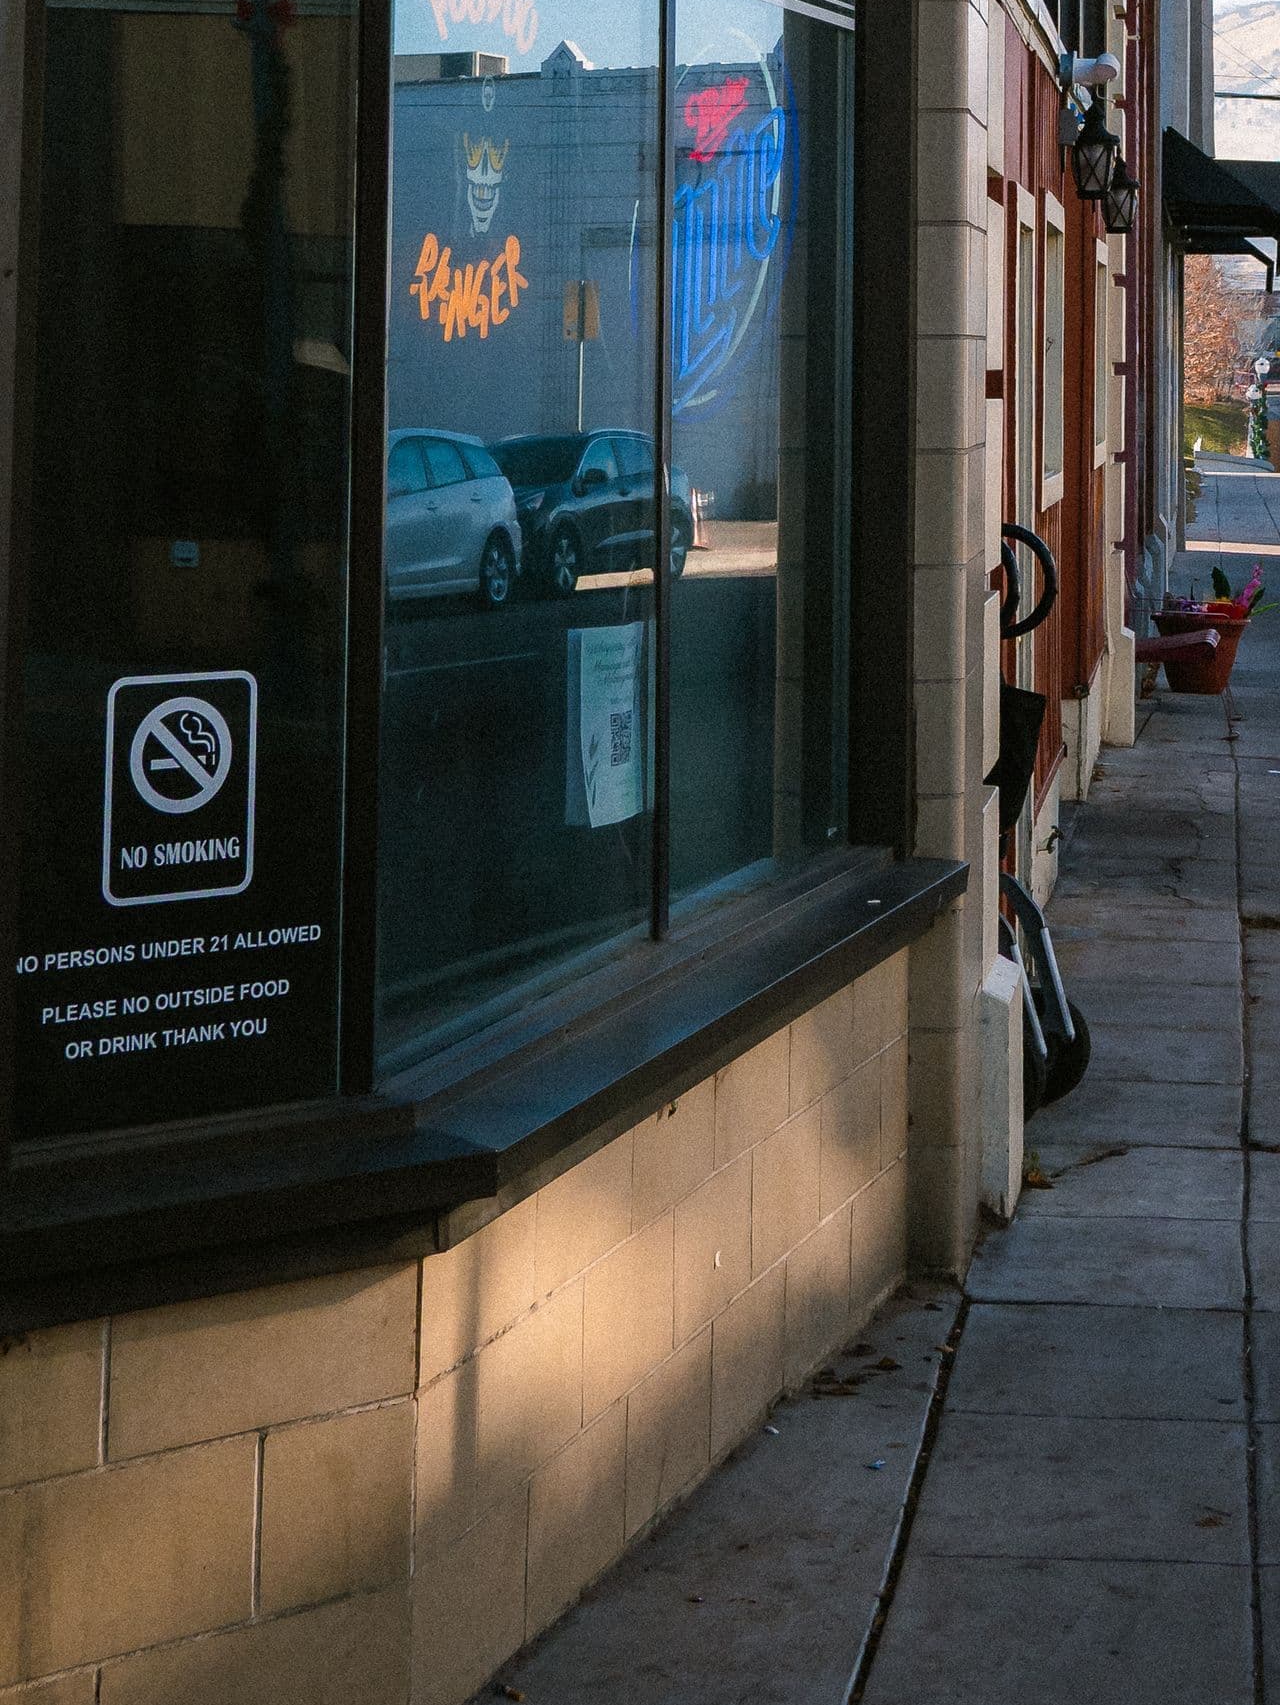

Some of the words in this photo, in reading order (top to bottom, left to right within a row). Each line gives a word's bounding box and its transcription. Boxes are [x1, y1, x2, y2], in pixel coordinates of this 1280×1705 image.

[121, 846, 147, 869] NO
[154, 837, 239, 866] SMOKING
[45, 945, 135, 970] PERSONS
[142, 938, 204, 959] UNDER
[210, 935, 227, 952] 21
[234, 925, 321, 949] ALLOWED
[43, 1000, 116, 1024] PLEASE
[123, 996, 149, 1014] NO
[156, 985, 234, 1010] OUTSIDE
[240, 980, 289, 1000] FOOD
[66, 1041, 93, 1059] OR
[99, 1032, 156, 1055] DRINK
[163, 1023, 224, 1046] THANK
[230, 1018, 267, 1037] YOU
